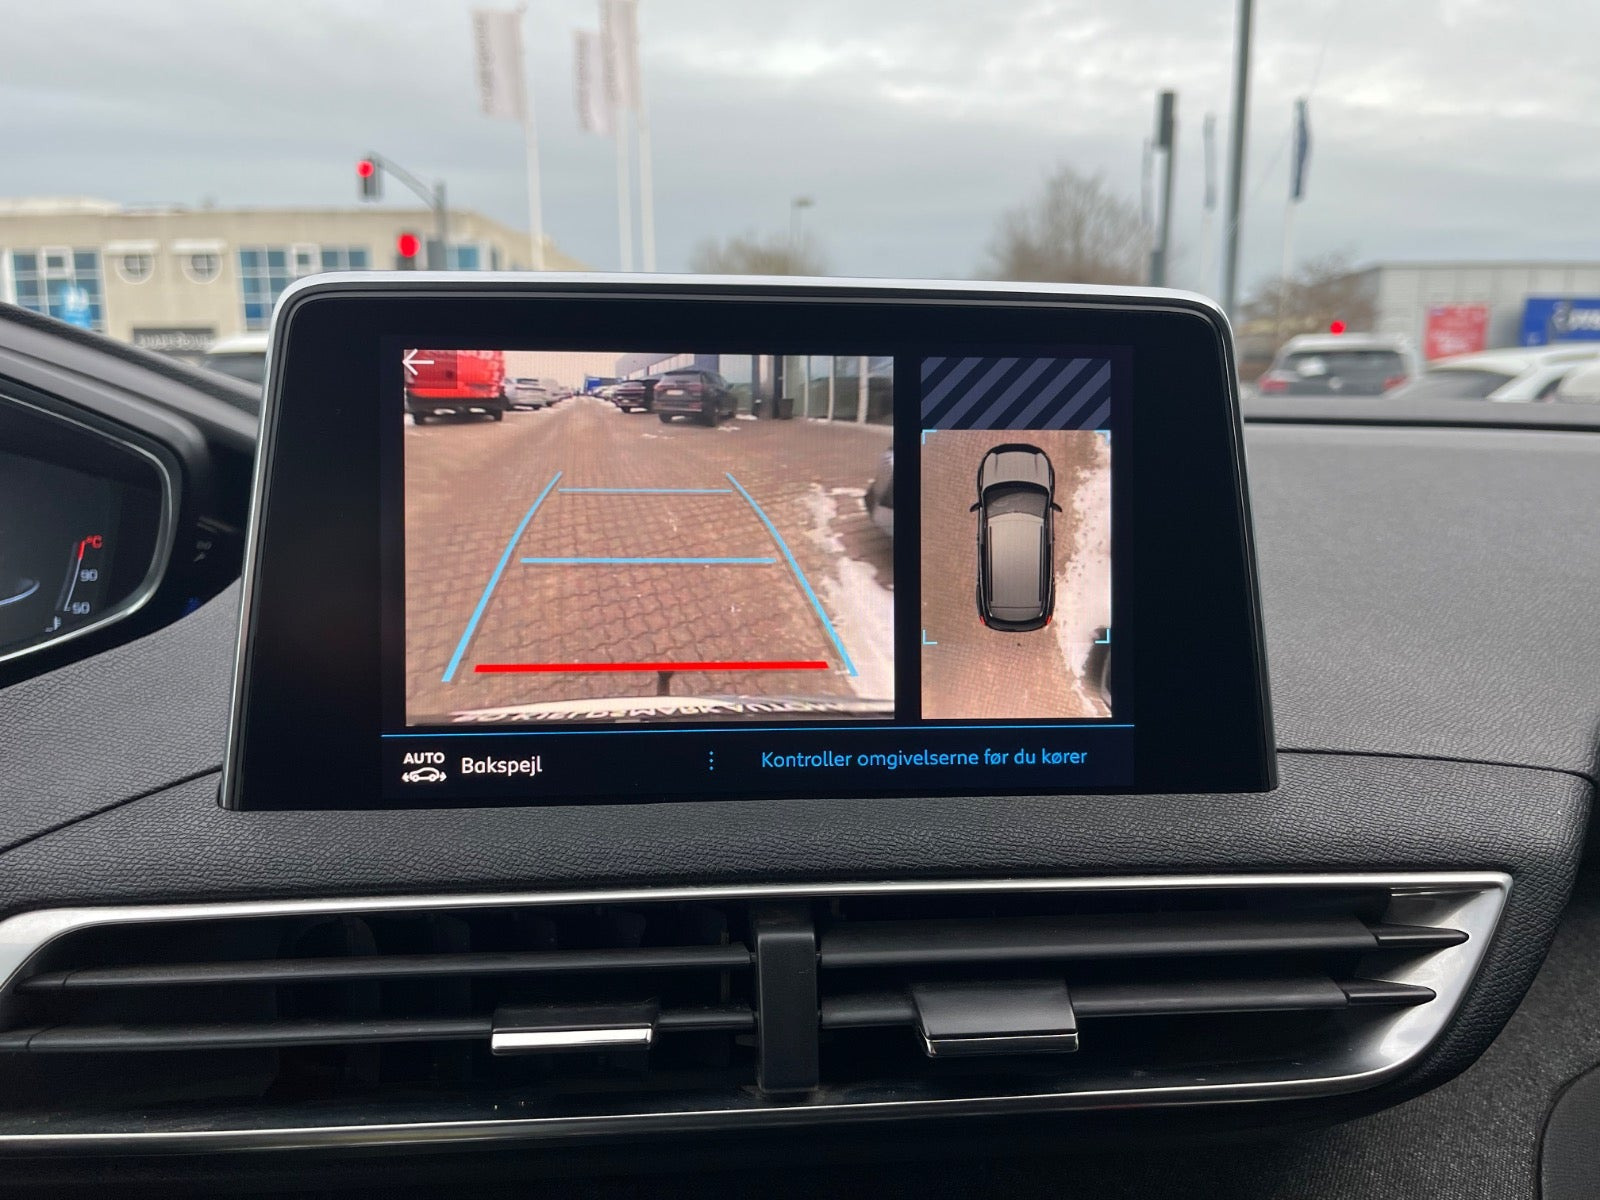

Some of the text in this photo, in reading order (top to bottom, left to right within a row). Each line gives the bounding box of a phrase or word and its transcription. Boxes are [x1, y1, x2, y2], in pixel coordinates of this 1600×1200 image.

[80, 569, 98, 582] 90
[403, 752, 445, 764] AUTO
[461, 755, 543, 777] Bakspejl
[762, 748, 1088, 770] Kontroller omgivelserne før du kører
